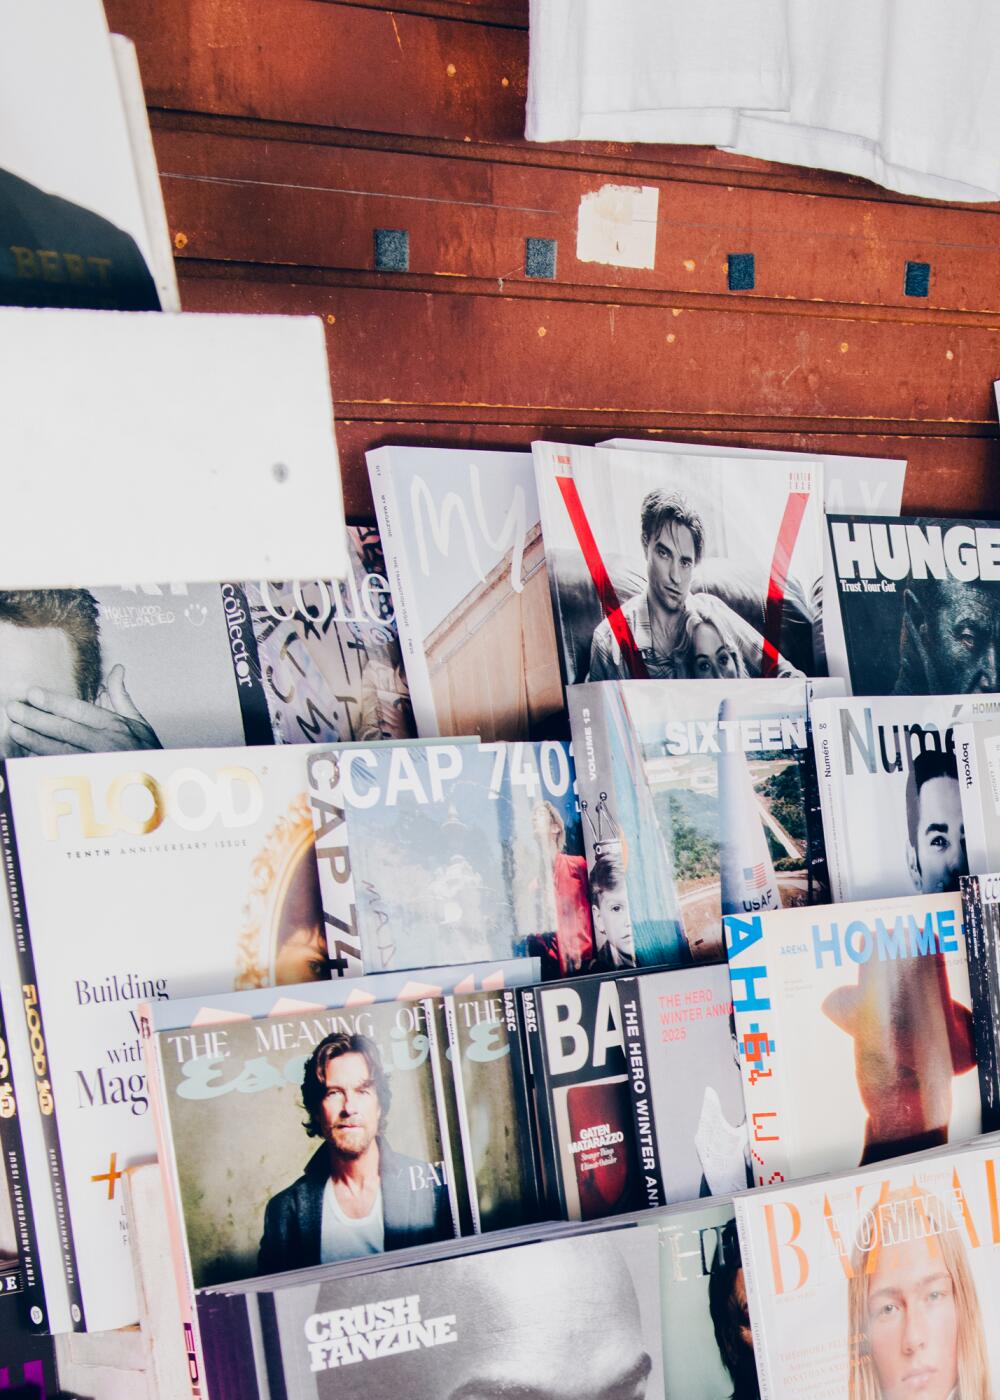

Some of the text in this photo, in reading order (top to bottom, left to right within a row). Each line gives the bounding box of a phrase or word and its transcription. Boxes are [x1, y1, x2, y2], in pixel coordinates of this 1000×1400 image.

[840, 580, 896, 592] Trust Your Gut
[222, 584, 252, 688] collector
[583, 708, 597, 782] VOLUME 13
[665, 717, 809, 756] SIXTEEN
[342, 744, 463, 809] CAP
[823, 738, 832, 778] Numéro
[961, 742, 973, 790] boycott.
[40, 766, 264, 841] FLOOD
[306, 750, 352, 885] CAP
[67, 839, 248, 860] TENTH ANNIVERSARY ISSUE
[4, 849, 22, 919] ANNIVERSARY
[16, 923, 27, 953] ISSUE
[742, 890, 774, 912] USAF
[780, 943, 809, 957] ARENA
[75, 973, 169, 1006] Building
[658, 989, 713, 1009] THE HERO
[22, 984, 47, 1076] FLOOD
[458, 999, 503, 1027] THE
[504, 991, 517, 1032] BASIC
[523, 992, 537, 1033] BASIC
[660, 1007, 703, 1025] WINTER
[168, 1031, 231, 1063] THE
[255, 1013, 374, 1054] MEANING
[623, 1000, 656, 1171] THE HERO WINTER
[567, 1130, 624, 1154] MATARAZZO
[579, 1123, 611, 1140] GATEN
[8, 1150, 18, 1181] ISSUE
[13, 1184, 32, 1252] ANNIVERSARY
[52, 1181, 71, 1253] ANNIVERSARY
[305, 1295, 420, 1344] CRUSH
[309, 1315, 457, 1371] FANZINE
